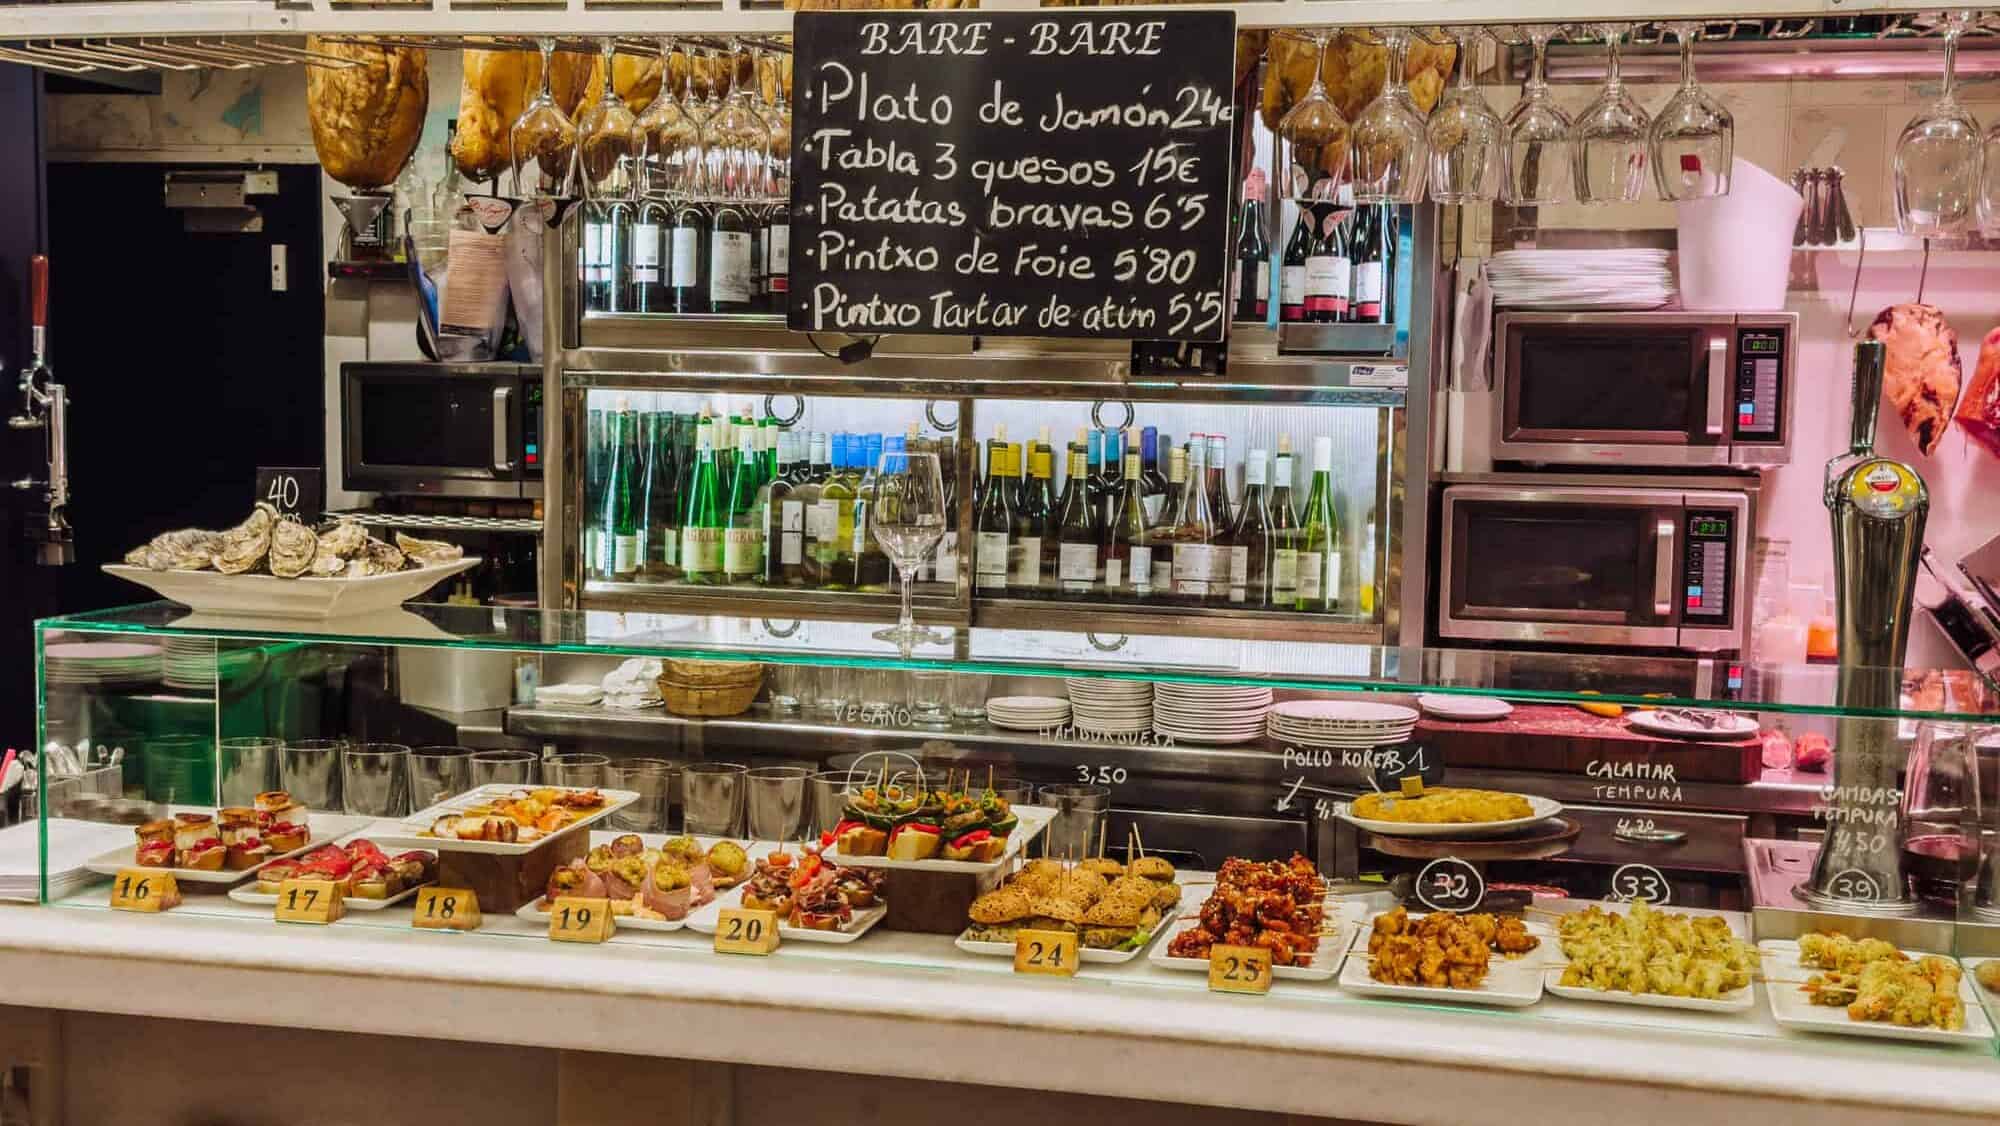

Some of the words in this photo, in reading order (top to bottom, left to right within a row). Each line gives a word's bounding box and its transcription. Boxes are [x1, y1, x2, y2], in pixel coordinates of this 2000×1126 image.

[860, 21, 992, 56] BARE
[1029, 21, 1166, 56] BARE
[820, 61, 953, 125] Plato
[980, 79, 1024, 126] de
[1039, 84, 1170, 133] Jamón
[813, 128, 921, 176] Tabla
[932, 142, 958, 181] 3
[971, 156, 1115, 197] quesos
[1128, 142, 1201, 187] 15€
[820, 182, 967, 226] Patatas
[990, 196, 1134, 230] bravas
[818, 230, 939, 271] Pintxo
[955, 235, 999, 274] de
[1014, 244, 1095, 279] Foie
[813, 282, 921, 331] Pintxo
[929, 290, 1028, 329] Tartar
[1038, 294, 1071, 328] de
[267, 475, 299, 513] 40
[833, 701, 912, 727] VEGANO
[1283, 747, 1333, 769] POLLO
[1077, 764, 1128, 785] 3,50
[1586, 760, 1676, 783] CALAMAR
[1593, 786, 1682, 801] TEMPURA
[118, 875, 151, 900] 16
[1432, 873, 1470, 899] 32
[1622, 875, 1659, 901] 33
[285, 887, 320, 912] 17
[424, 894, 457, 920] 18
[558, 906, 592, 931] 19
[725, 916, 763, 943] 20
[1026, 941, 1064, 967] 24
[1223, 955, 1262, 982] 25
